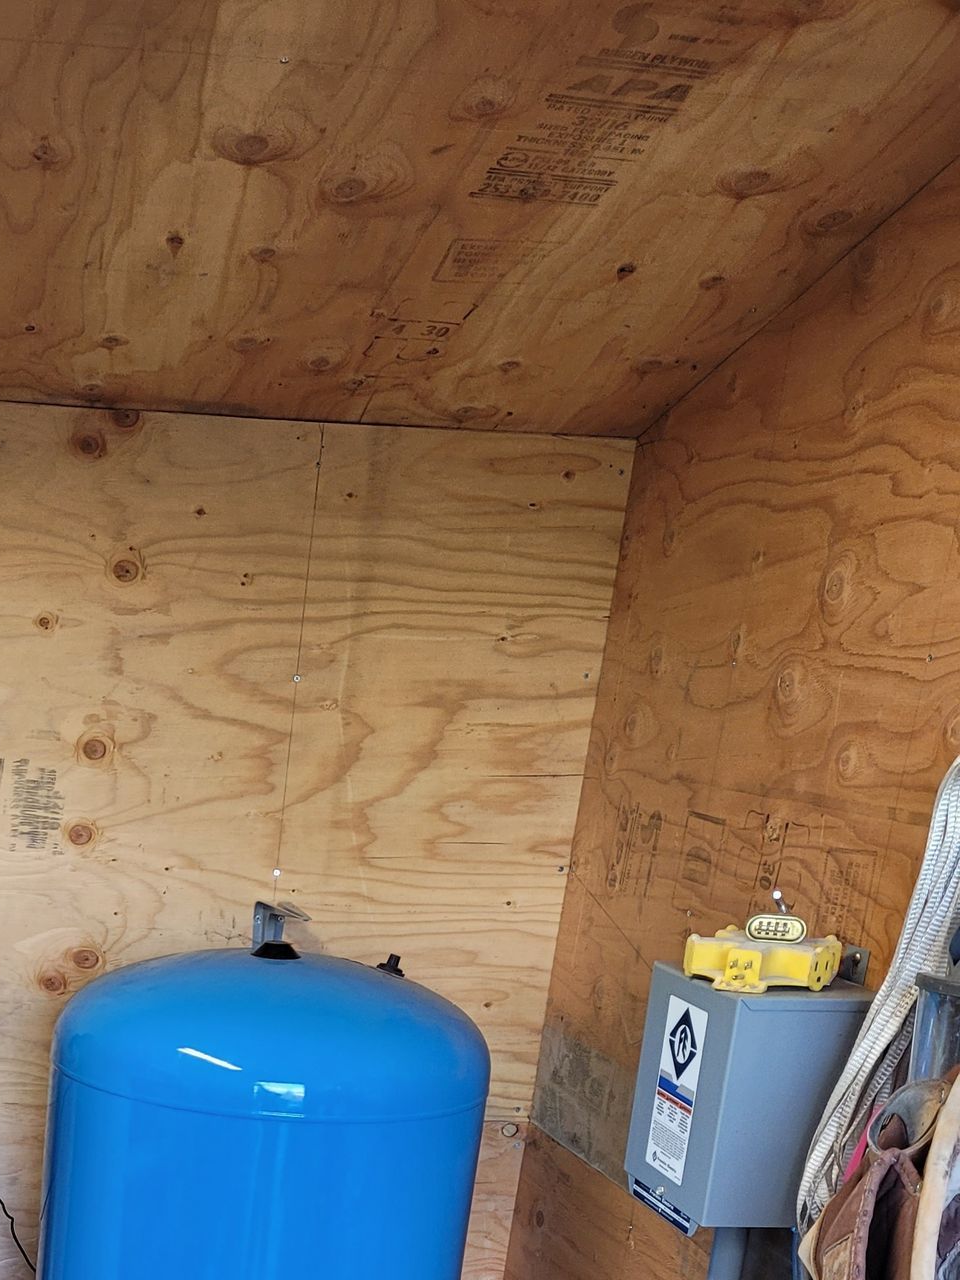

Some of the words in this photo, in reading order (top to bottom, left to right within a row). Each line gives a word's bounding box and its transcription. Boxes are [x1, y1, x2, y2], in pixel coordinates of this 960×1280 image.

[564, 73, 694, 103] APA
[420, 325, 450, 338] 30
[759, 861, 775, 891] 30
